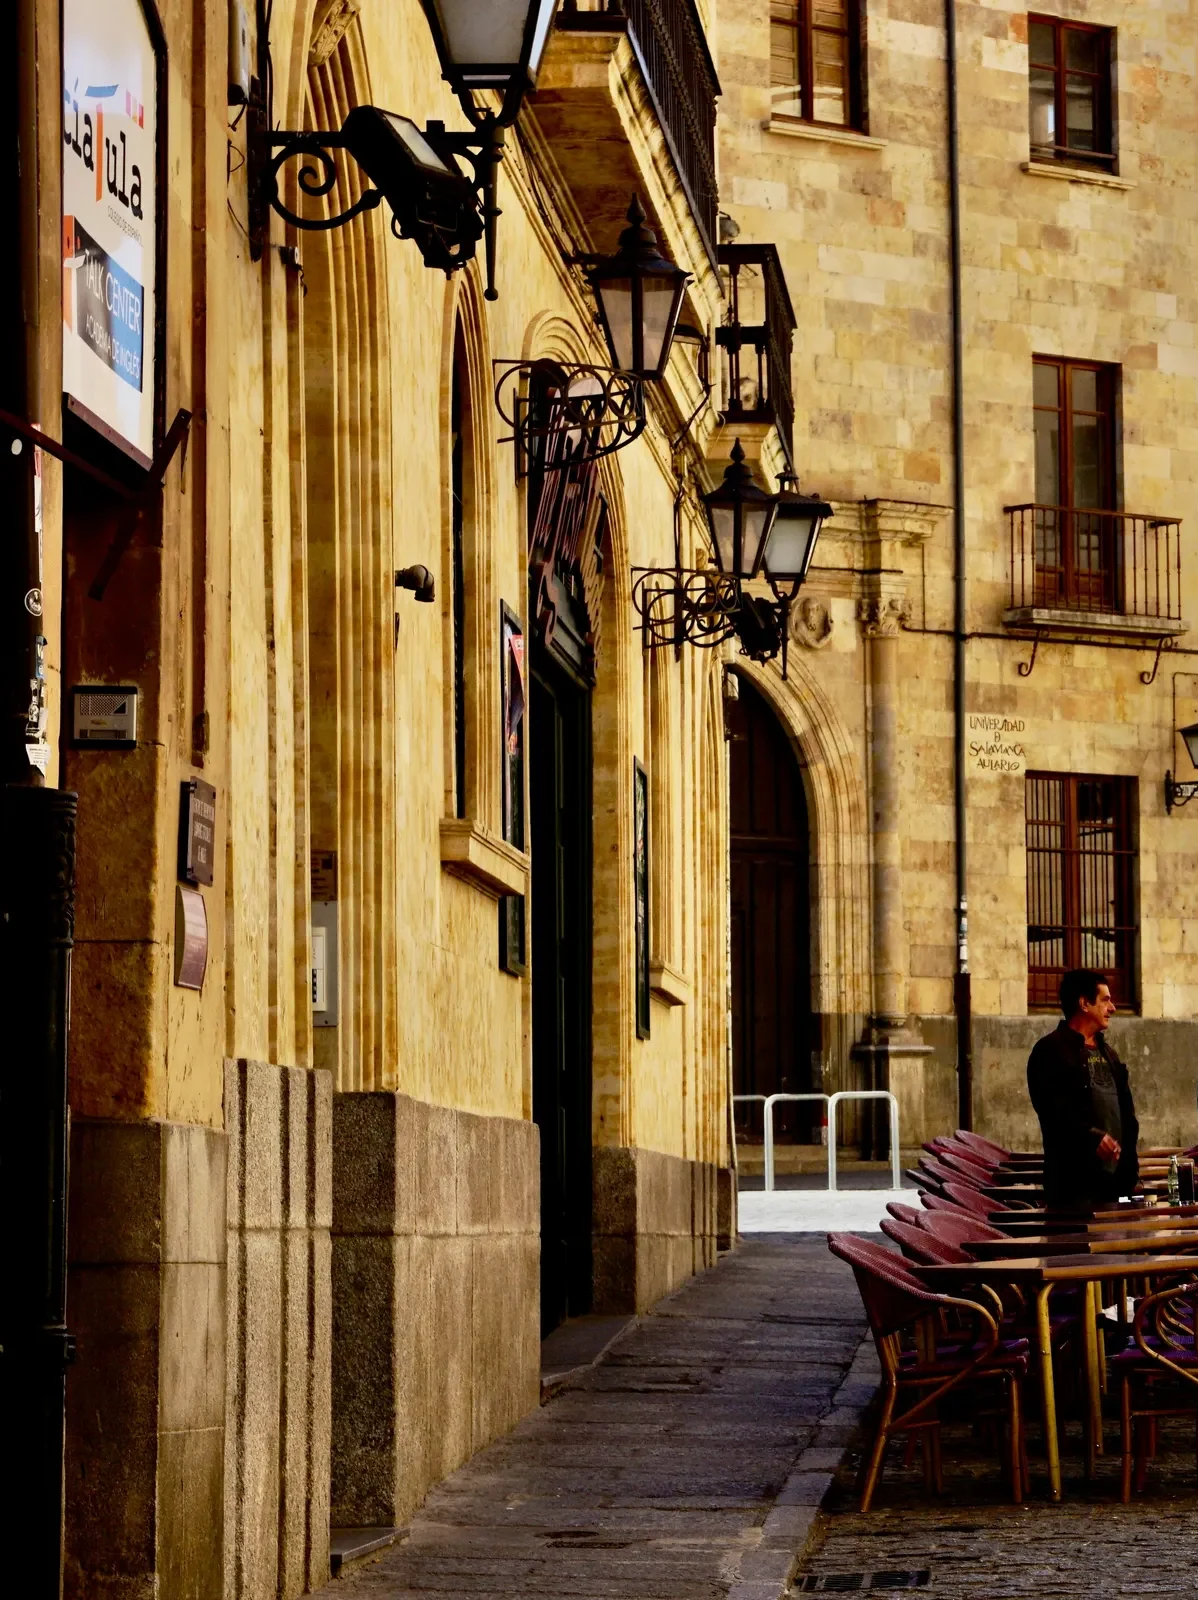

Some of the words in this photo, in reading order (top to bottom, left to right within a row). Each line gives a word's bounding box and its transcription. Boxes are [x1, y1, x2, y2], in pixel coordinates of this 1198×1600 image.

[85, 248, 104, 303] TALK
[105, 271, 141, 335] CENTER
[86, 314, 112, 357] ACADEMIA
[111, 338, 120, 364] DE
[119, 349, 141, 380] INGLÉS
[977, 758, 1020, 771] AULARIO
